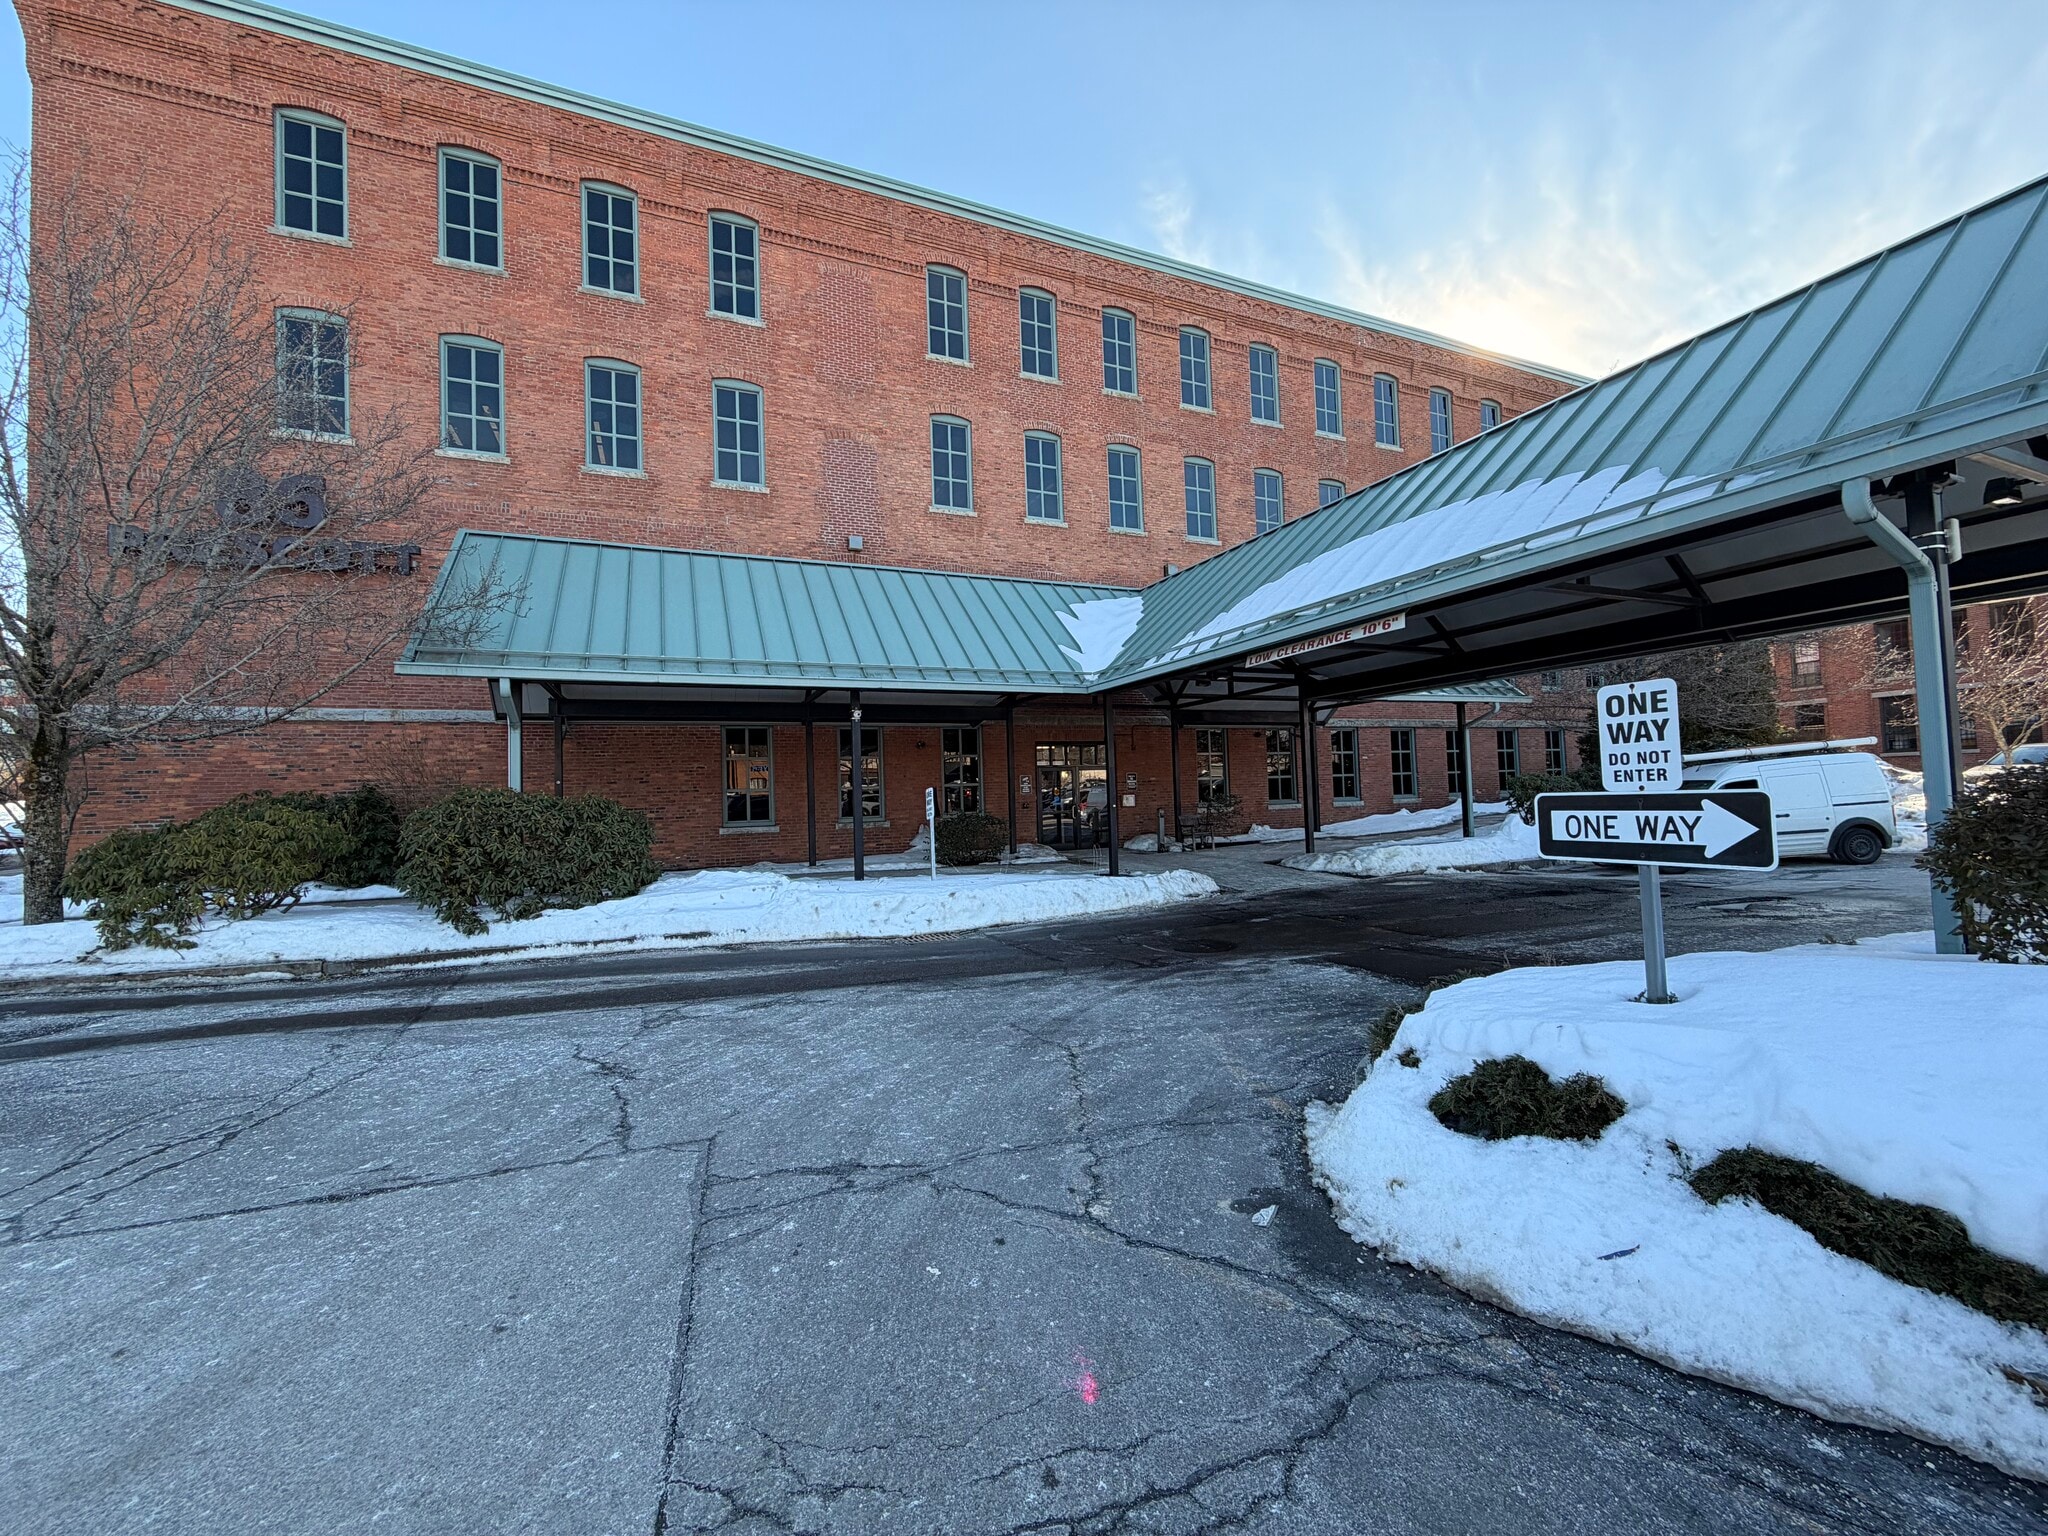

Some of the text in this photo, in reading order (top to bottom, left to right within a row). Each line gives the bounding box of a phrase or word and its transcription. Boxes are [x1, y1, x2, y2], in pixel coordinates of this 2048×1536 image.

[1249, 617, 1399, 665] LOW CLEARANCE 10'6"
[1605, 689, 1669, 718] ONE
[1607, 718, 1670, 745] WAY
[1608, 750, 1671, 766] DO NOT
[1613, 768, 1668, 783] ENTER
[1565, 814, 1703, 842] ONE WAY
